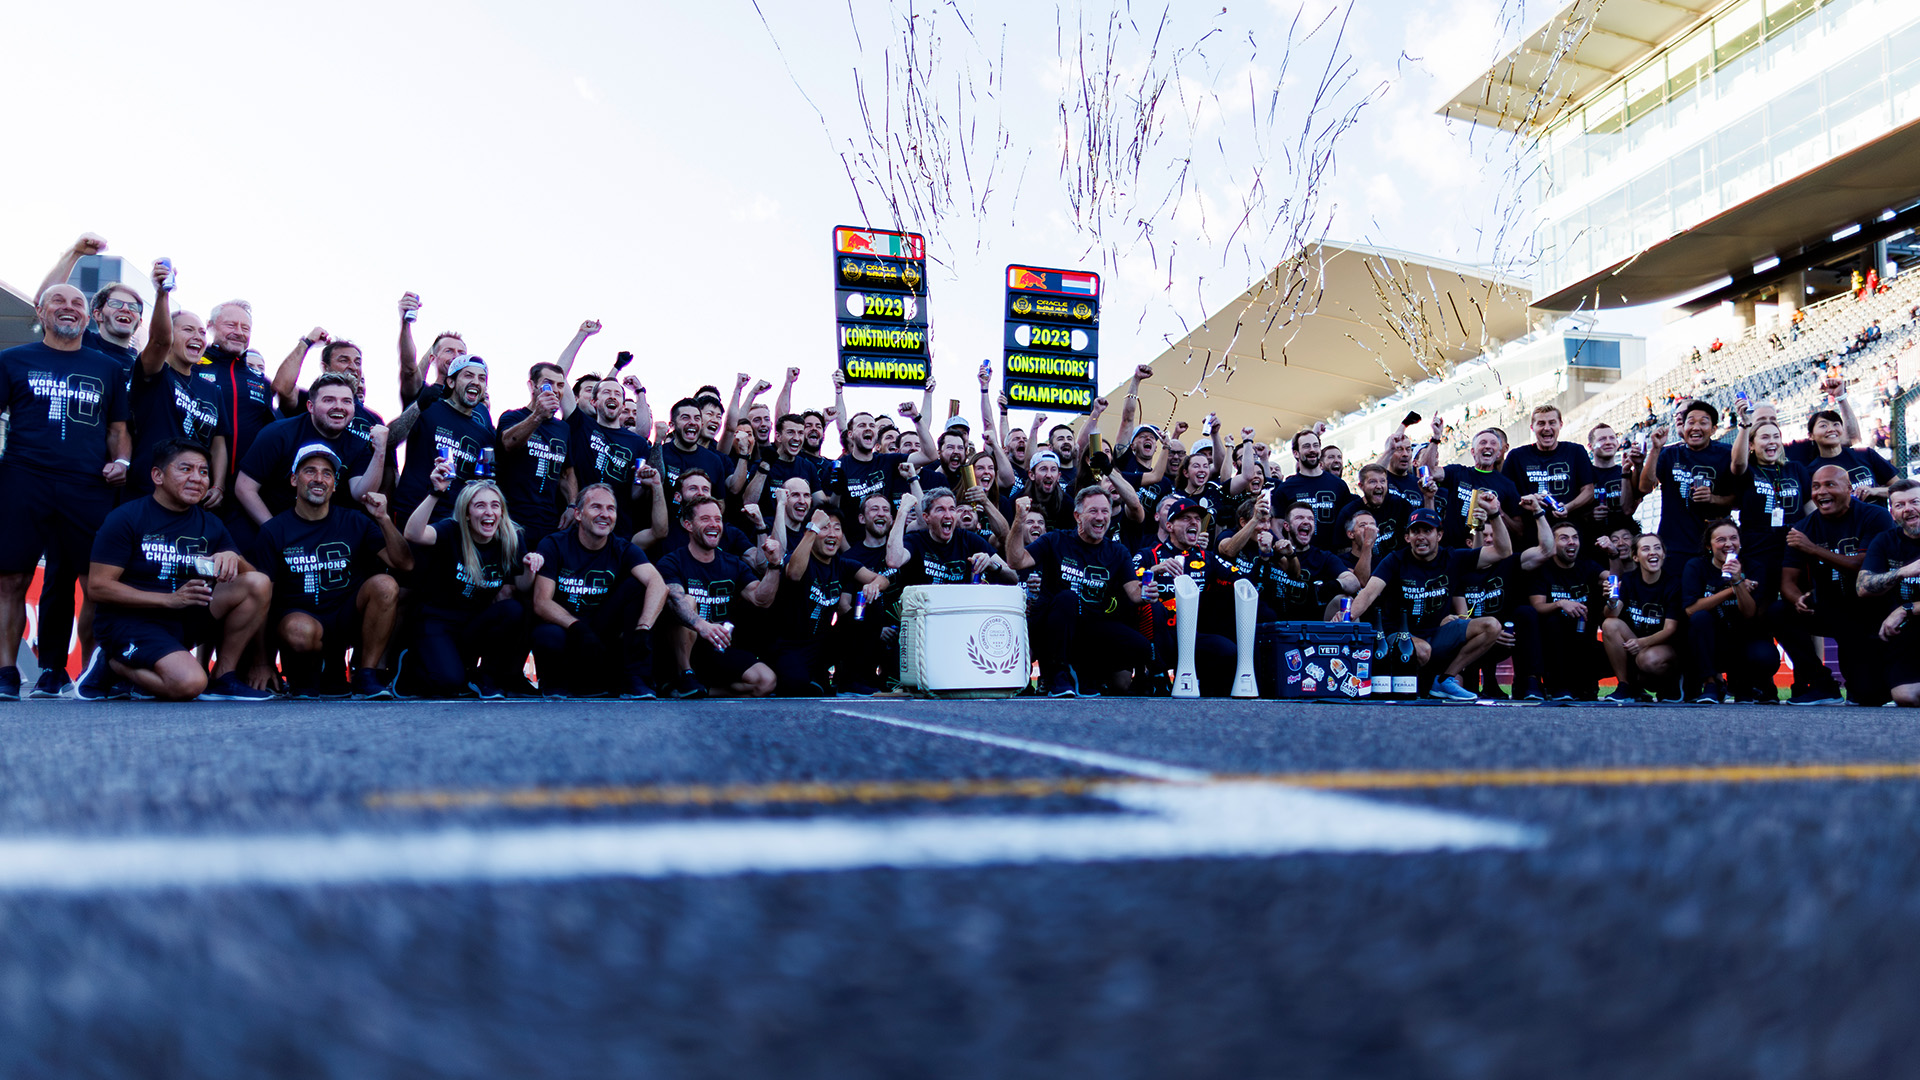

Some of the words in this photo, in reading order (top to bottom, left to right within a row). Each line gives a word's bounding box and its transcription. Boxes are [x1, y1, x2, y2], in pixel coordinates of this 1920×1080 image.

[866, 296, 903, 317] 2023
[846, 328, 923, 350] CONSTRUCTORS'
[1031, 328, 1070, 347] 2023
[847, 361, 925, 381] CHAMPIONS
[1008, 355, 1088, 377] CONSTRUCTORS'
[28, 379, 66, 389] WORLD
[33, 387, 100, 403] CHAMPIONS
[175, 387, 197, 408] WORLD
[1010, 385, 1091, 406] CHAMPIONS
[175, 399, 218, 427] CHAMPIONS
[434, 434, 460, 448] WORLD
[527, 441, 550, 451] WORLD
[528, 448, 566, 463] CHAMPIONS
[1529, 473, 1567, 482] CHAMPIONS
[850, 481, 884, 497] CHAMPIONS
[141, 543, 175, 553] WORLD
[284, 555, 317, 565] WORLD
[290, 560, 347, 573] CHAMPIONS
[923, 560, 946, 571] WORLD
[925, 567, 964, 581] CHAMPIONS
[1060, 564, 1084, 578] WORLD
[558, 576, 583, 586] WORLD
[1061, 572, 1104, 588] CHAMPIONS
[1269, 573, 1305, 589] CHAMPIONS
[559, 584, 609, 595] CHAMPIONS
[1404, 588, 1446, 600] CHAMPIONS
[694, 595, 730, 604] HAMPIONS
